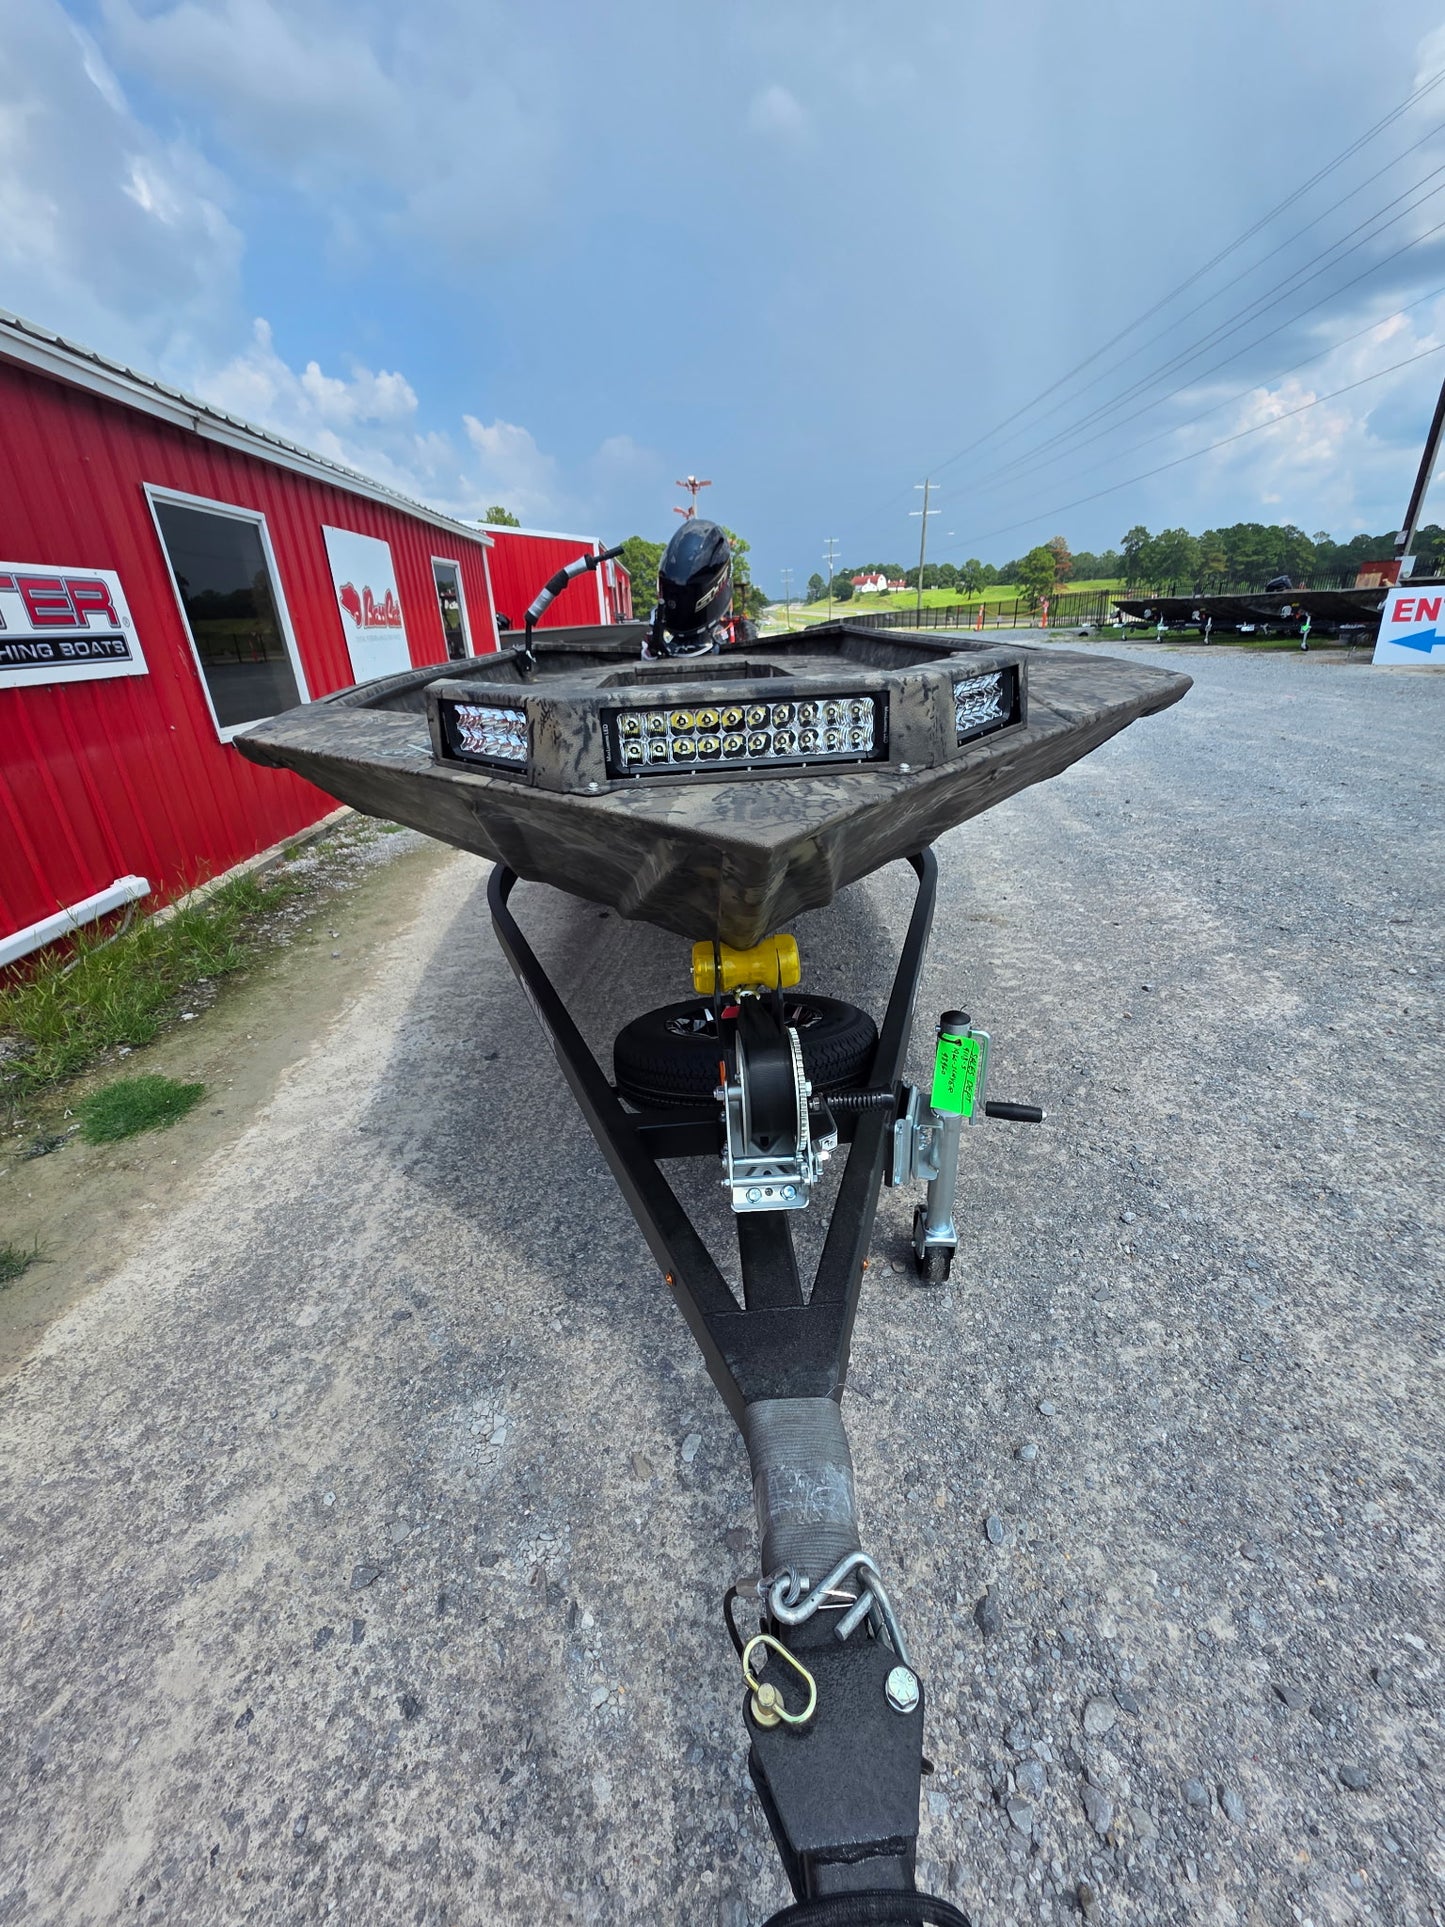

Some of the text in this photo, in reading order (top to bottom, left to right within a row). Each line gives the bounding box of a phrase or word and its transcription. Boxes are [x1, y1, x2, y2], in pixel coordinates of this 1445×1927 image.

[1391, 597, 1445, 623] EN
[58, 640, 126, 656] BOATS
[964, 1053, 978, 1104] SALES DEPT
